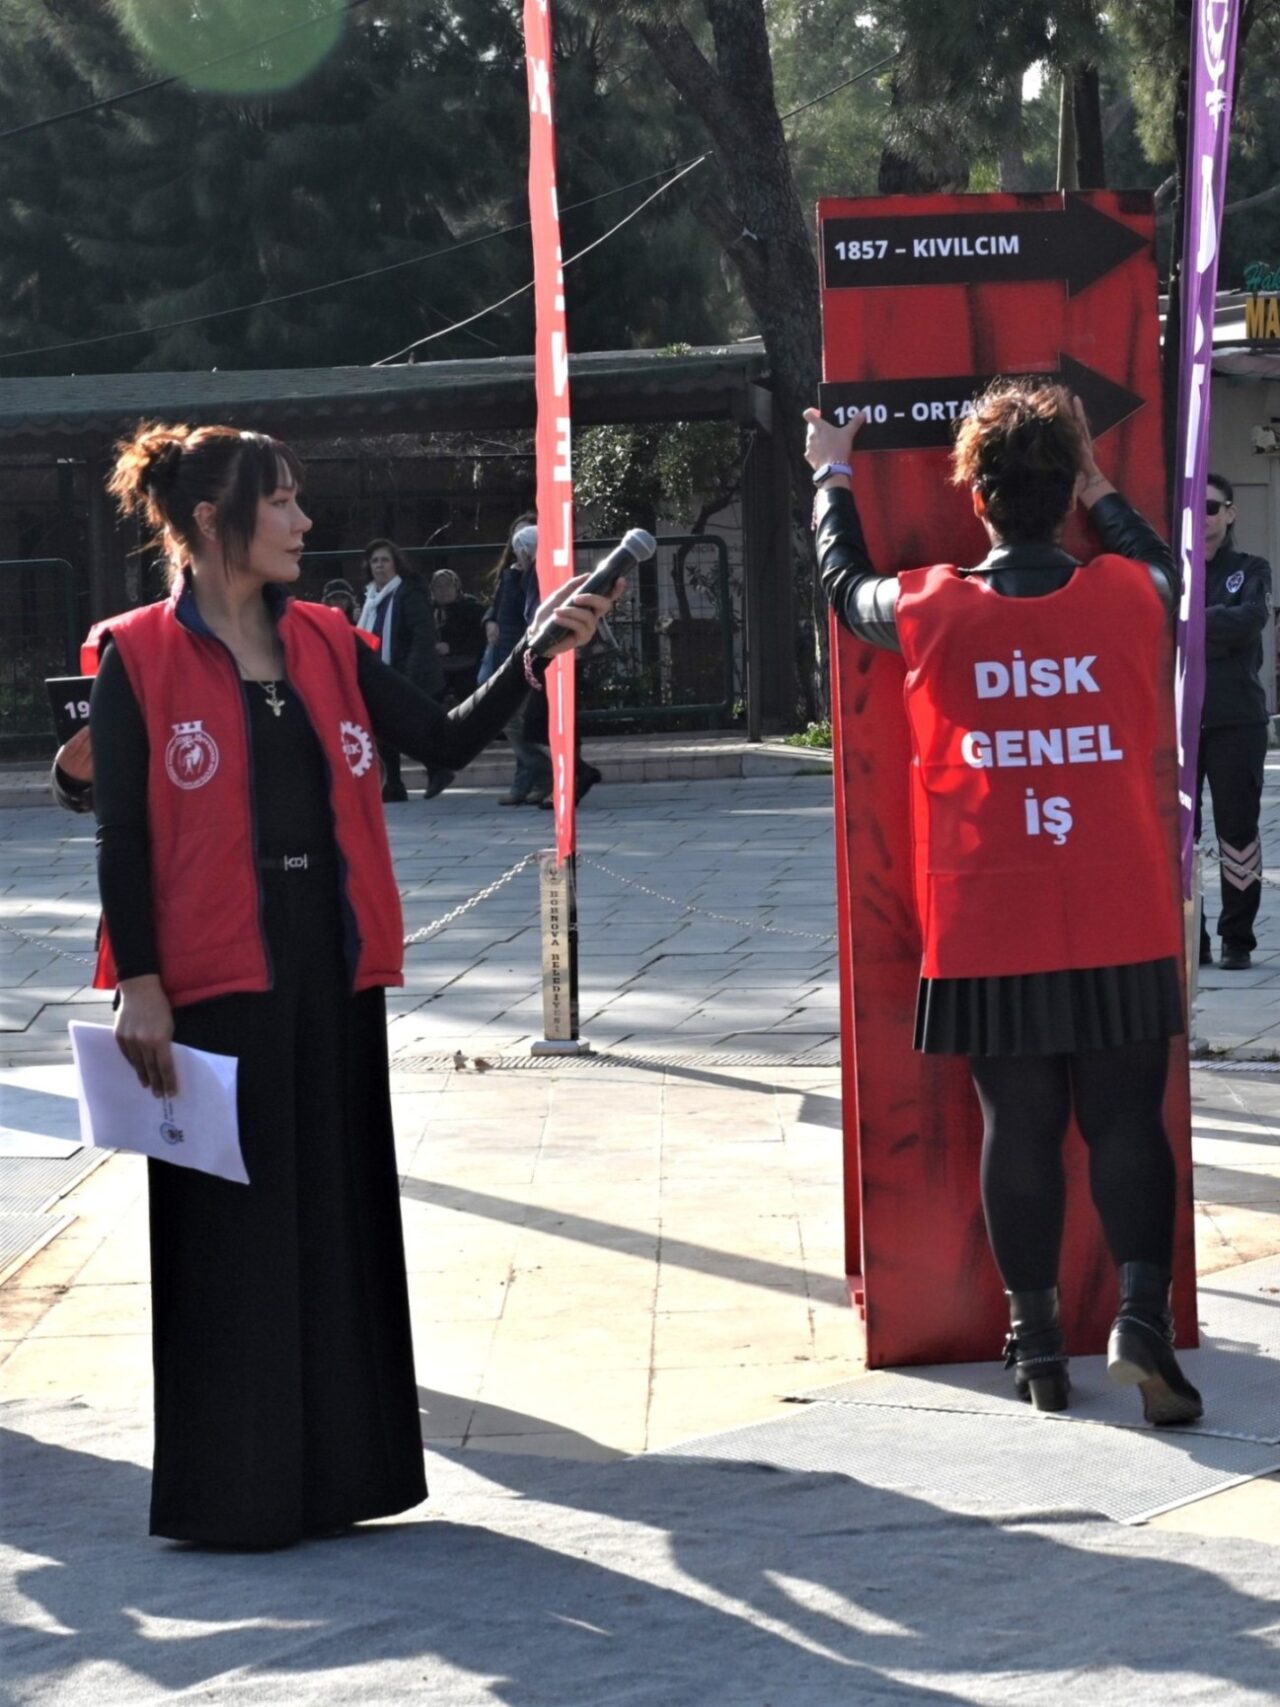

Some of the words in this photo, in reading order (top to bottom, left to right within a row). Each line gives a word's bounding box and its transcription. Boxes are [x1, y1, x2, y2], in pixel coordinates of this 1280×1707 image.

[834, 240, 889, 260] 1857
[913, 235, 1020, 258] KIVILCIM
[834, 404, 888, 425] 1910
[911, 400, 978, 421] ORTA
[974, 650, 1100, 699] DİSK
[961, 724, 1123, 769] GENEL
[1024, 787, 1073, 845] İŞ
[549, 890, 560, 946] BORNOVA
